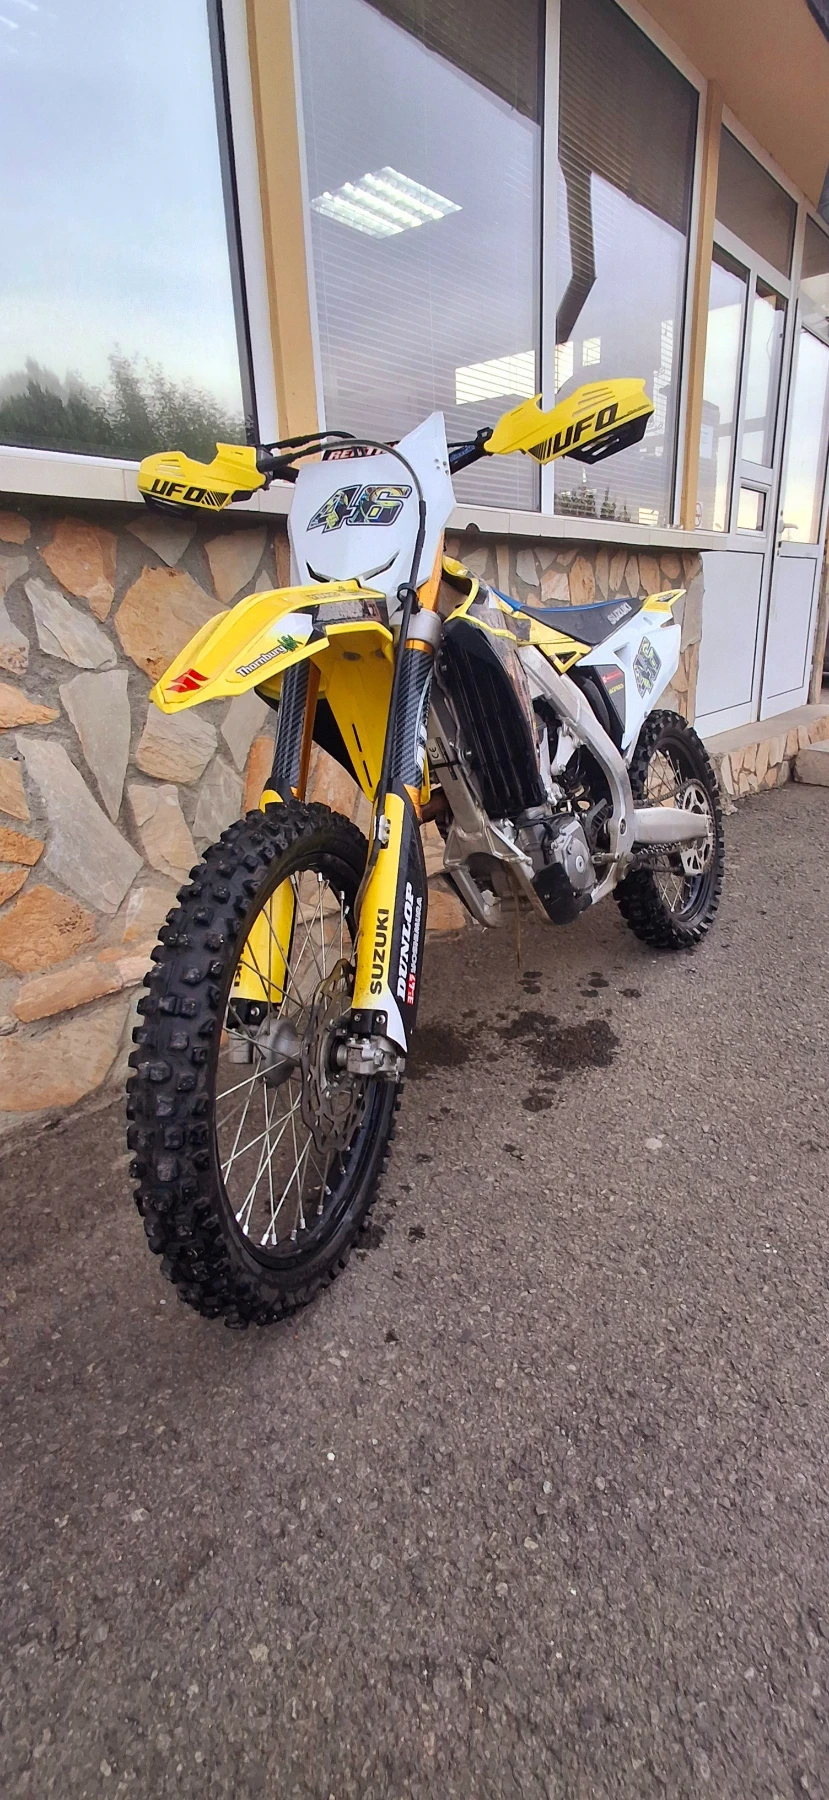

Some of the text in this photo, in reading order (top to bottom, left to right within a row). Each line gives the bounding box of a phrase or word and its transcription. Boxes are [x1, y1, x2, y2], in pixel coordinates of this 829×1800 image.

[552, 402, 619, 454] UFO
[150, 479, 205, 502] UFO
[306, 484, 412, 534] 46
[607, 602, 632, 625] SUZUKI
[236, 644, 288, 677] Thornbury
[370, 908, 389, 995] SUZUKI
[397, 881, 413, 1002] DUNLOP
